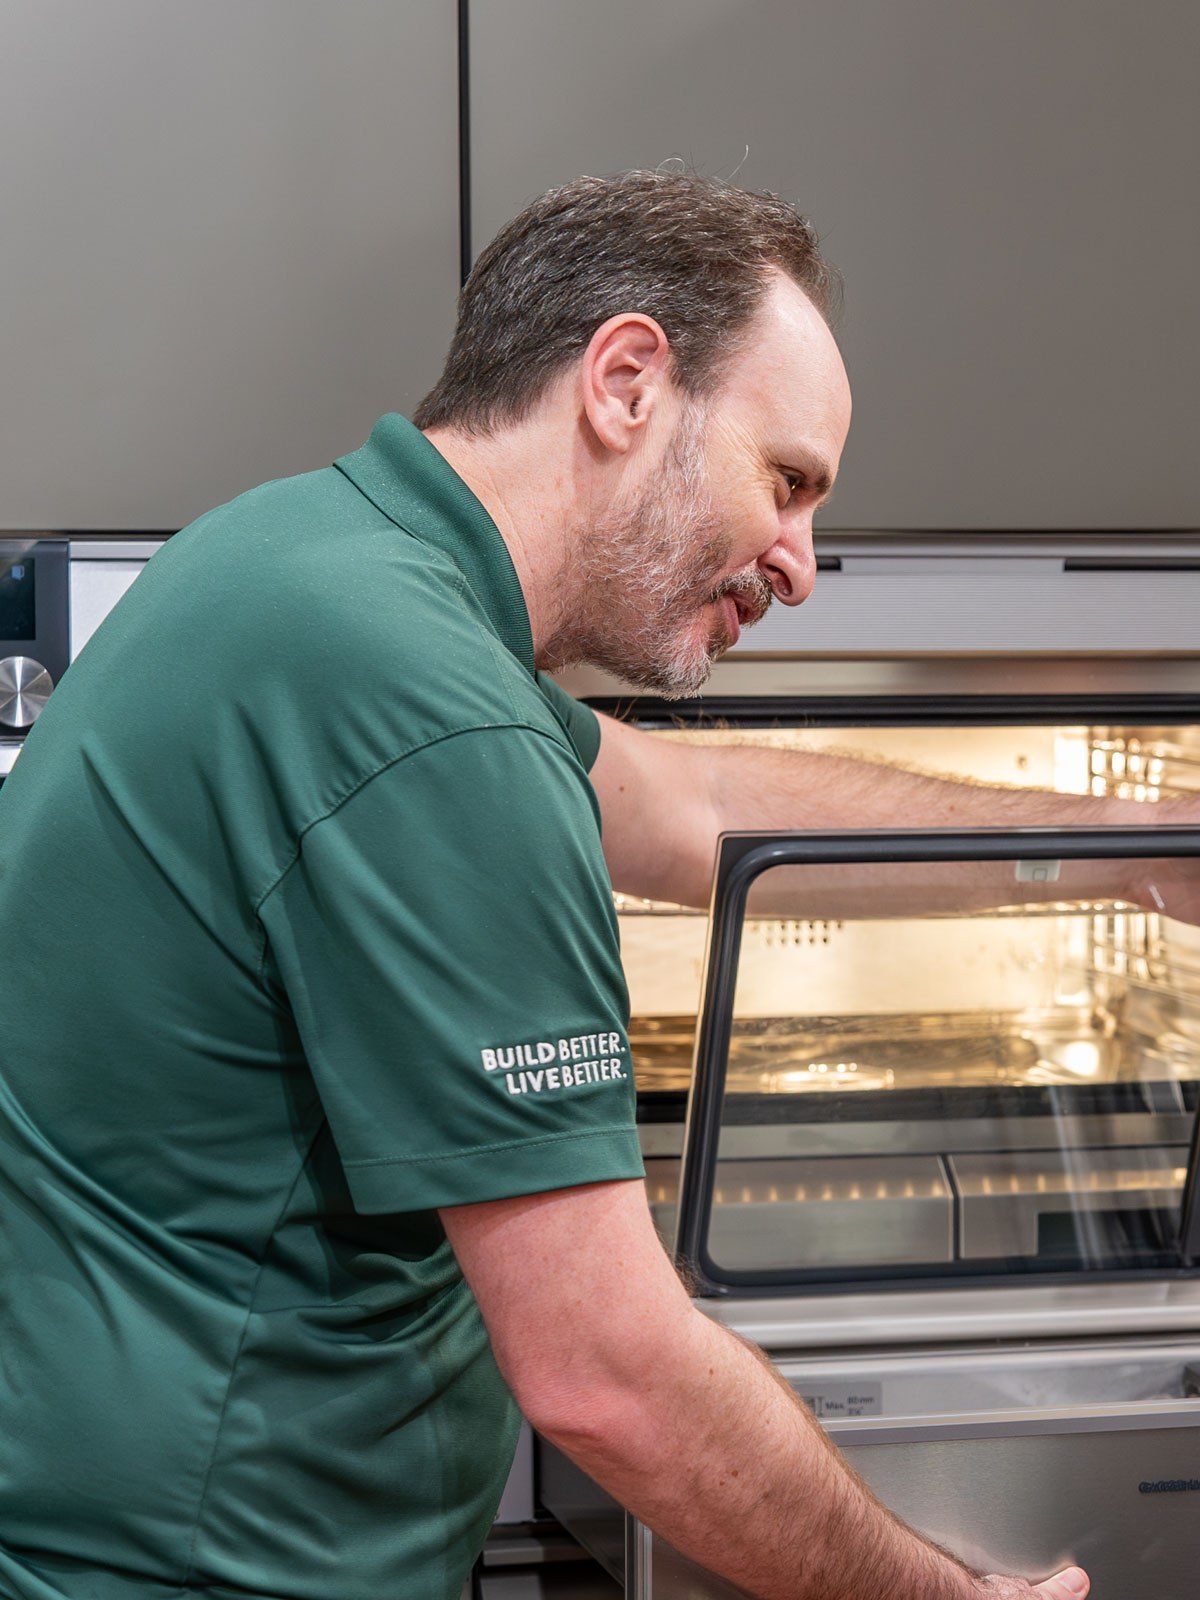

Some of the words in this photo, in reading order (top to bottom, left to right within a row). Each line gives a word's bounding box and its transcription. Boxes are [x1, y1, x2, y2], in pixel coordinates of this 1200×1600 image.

[480, 1042, 556, 1072] BUILD
[558, 1032, 626, 1061] BETTER.
[505, 1067, 561, 1095] LIVE
[561, 1058, 628, 1087] BETTER.
